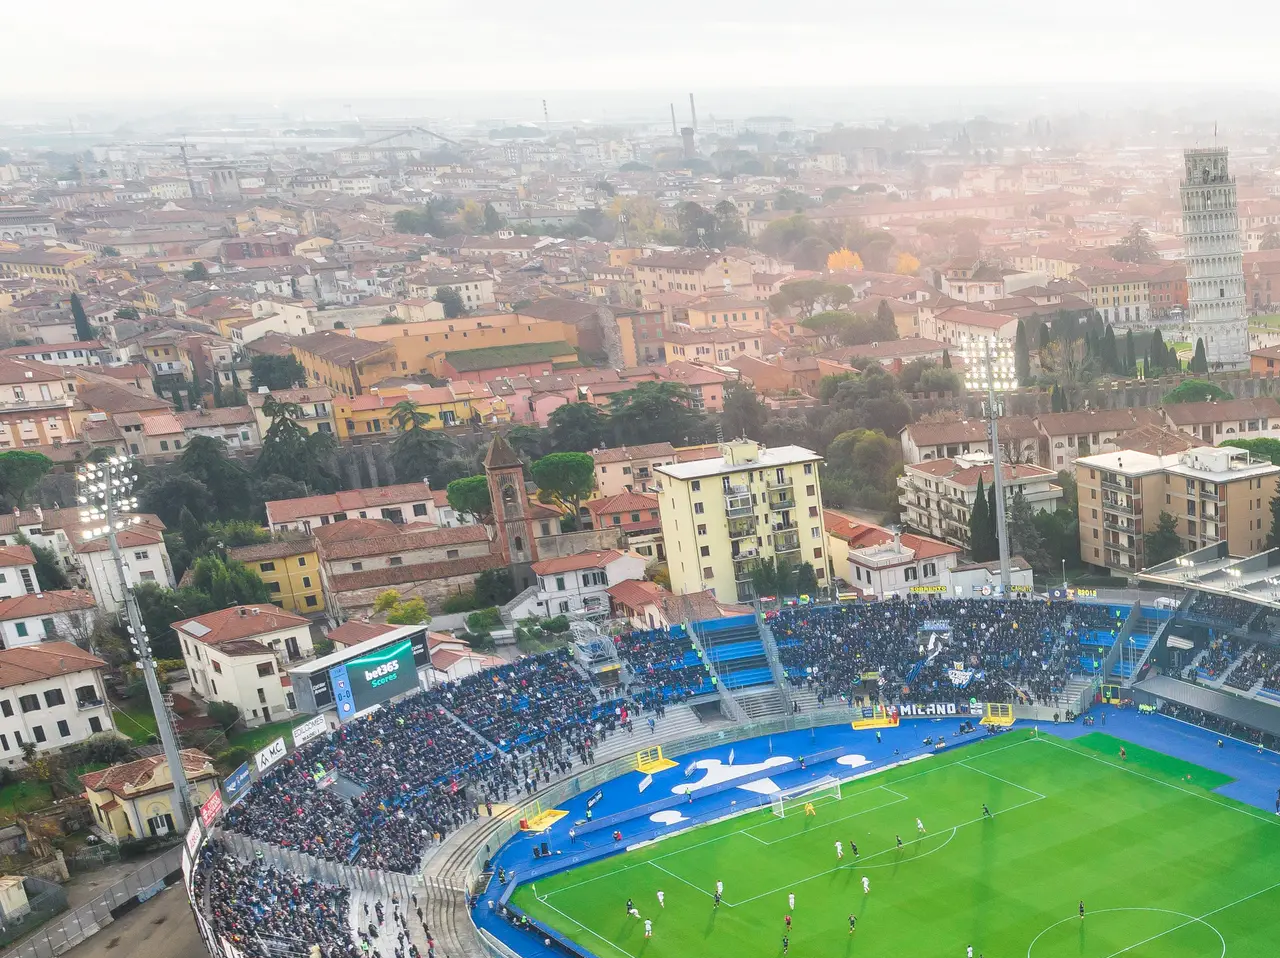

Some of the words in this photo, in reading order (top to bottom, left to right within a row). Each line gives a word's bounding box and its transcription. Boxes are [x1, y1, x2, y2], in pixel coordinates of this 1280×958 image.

[365, 660, 399, 681] bet365
[371, 672, 398, 688] Scores
[900, 703, 957, 715] MILANO
